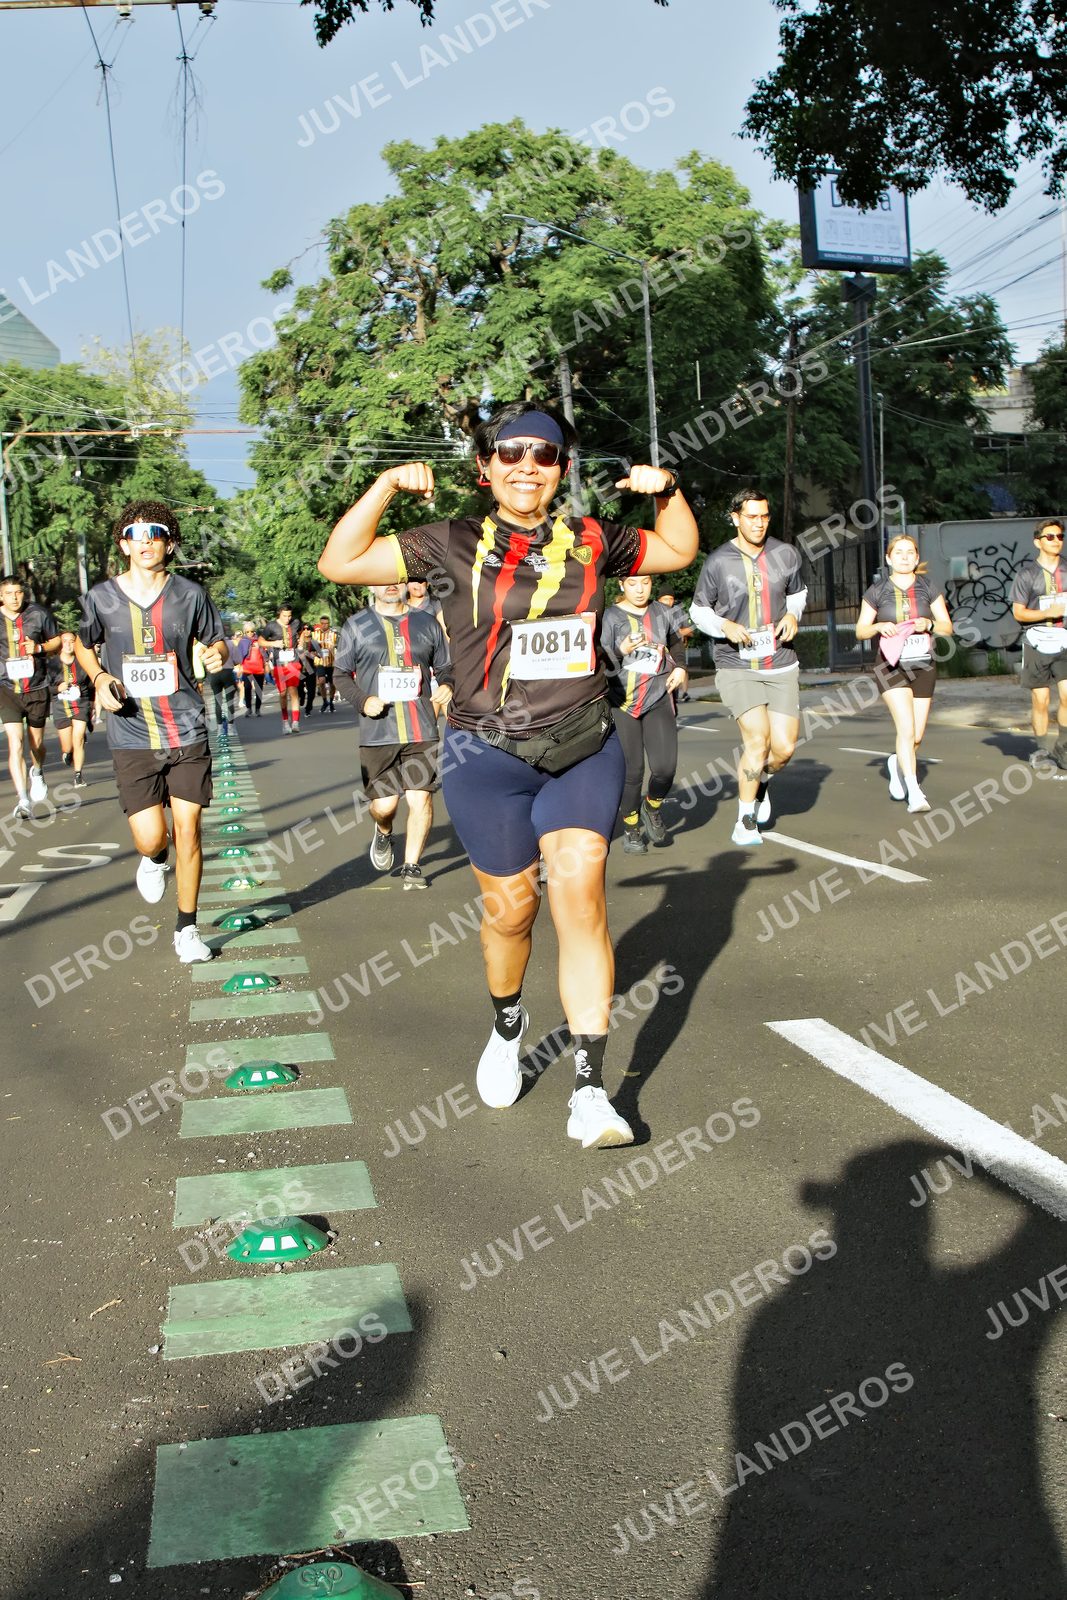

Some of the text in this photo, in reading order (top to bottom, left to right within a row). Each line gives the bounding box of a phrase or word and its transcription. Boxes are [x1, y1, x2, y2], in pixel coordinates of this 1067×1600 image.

[968, 541, 1018, 561] TOY
[517, 628, 587, 655] 10814
[130, 668, 166, 683] 8603
